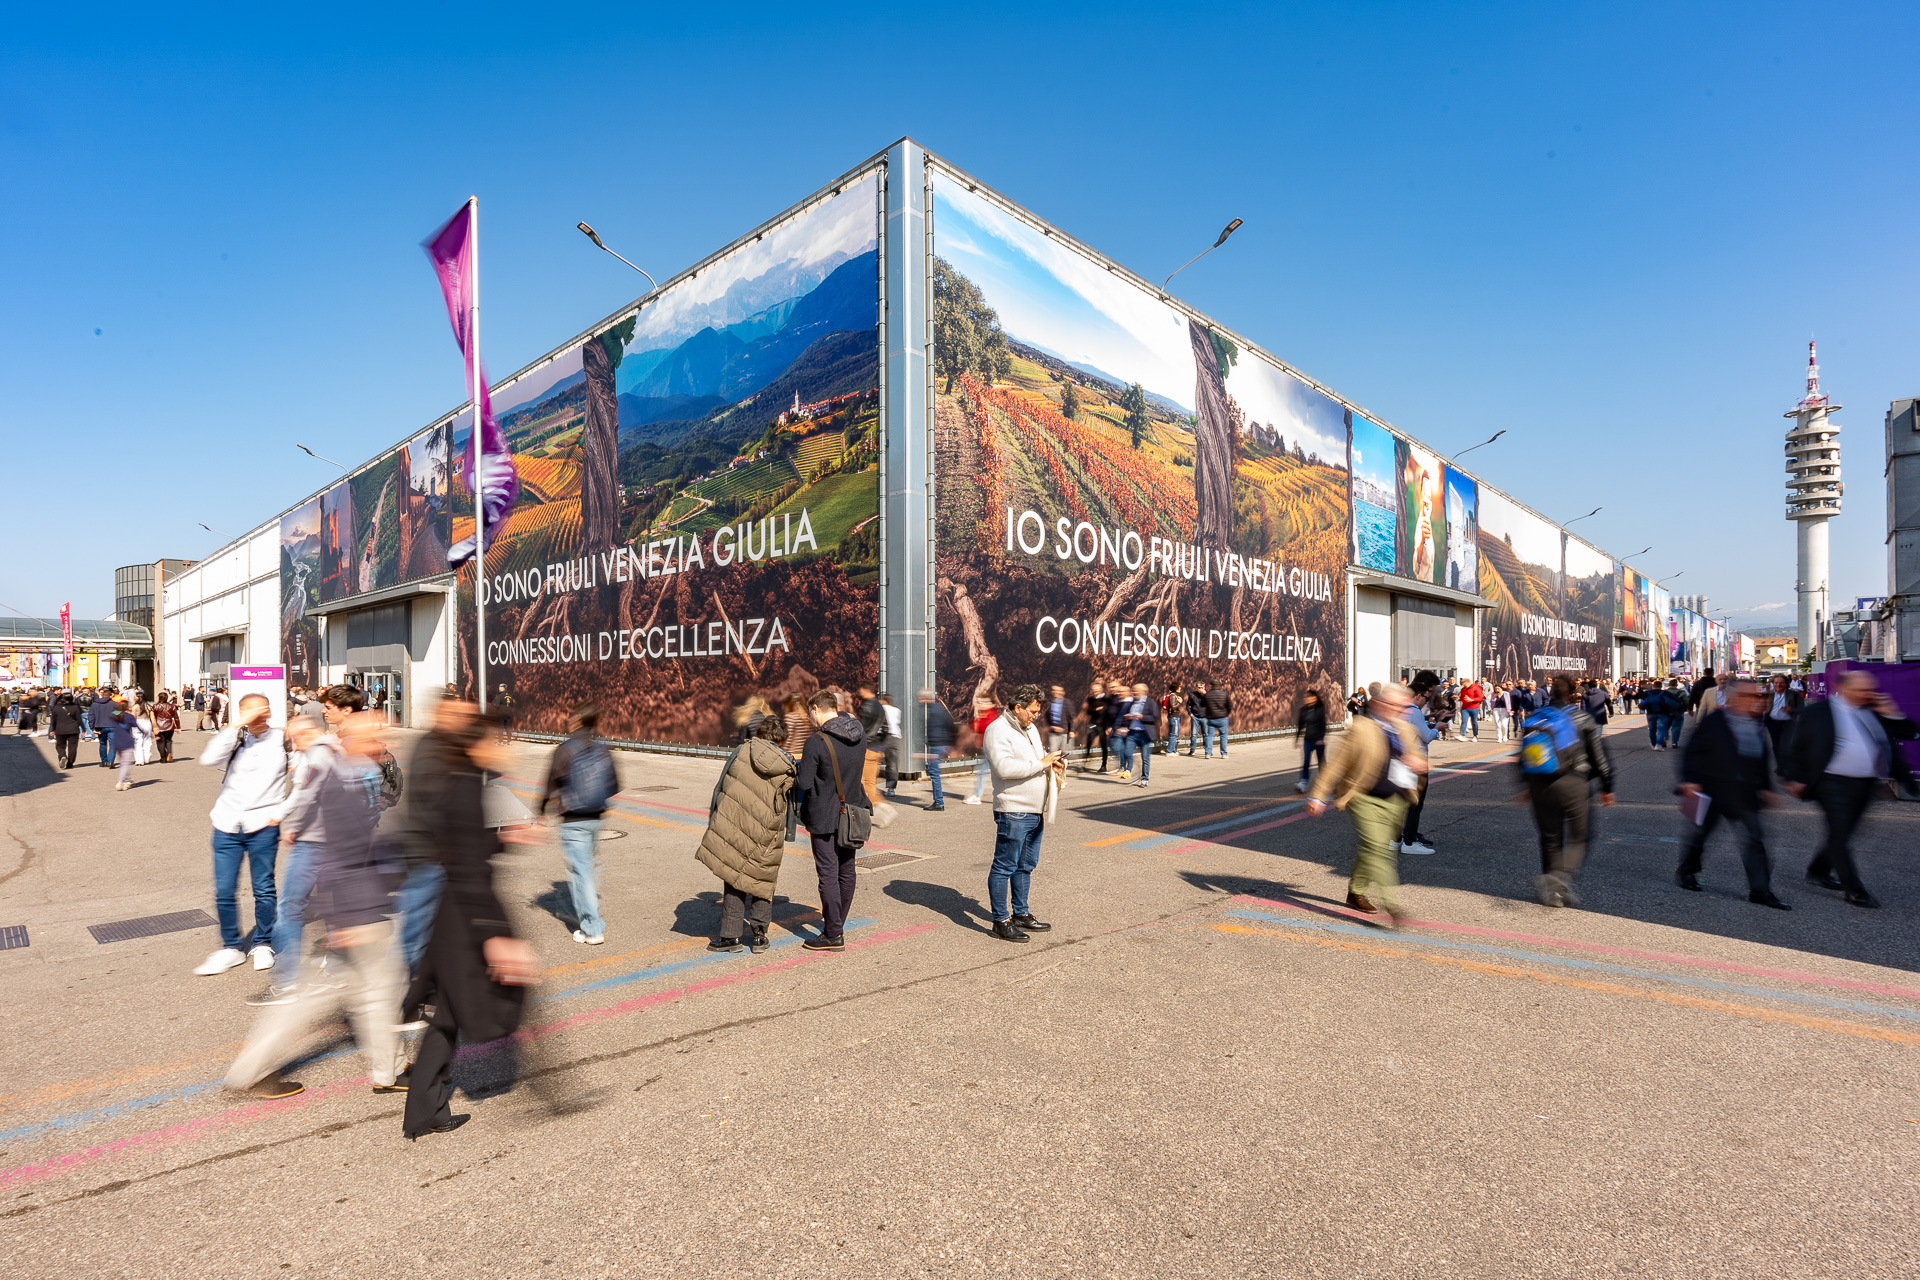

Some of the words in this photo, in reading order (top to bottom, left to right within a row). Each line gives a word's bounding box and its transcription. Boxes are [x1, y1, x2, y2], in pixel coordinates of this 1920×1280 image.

[494, 566, 541, 604] SONO
[546, 554, 596, 596] FRIULI
[601, 532, 705, 586] VENEZIA
[713, 507, 818, 567] GIULIA
[1007, 507, 1046, 555] IO
[1056, 516, 1143, 571] SONO
[1150, 536, 1210, 583] FRIULI
[1215, 550, 1287, 595] VENEZIA
[1289, 567, 1332, 603] GIULIA
[487, 633, 591, 666] CONNESSIONI
[599, 616, 789, 661] D'ECCELLENZA
[1035, 616, 1200, 659] CONNESSIONI
[1208, 628, 1321, 662] D'ECCELLENZA
[1528, 613, 1546, 637] SONO
[1580, 624, 1597, 643] GIULIA
